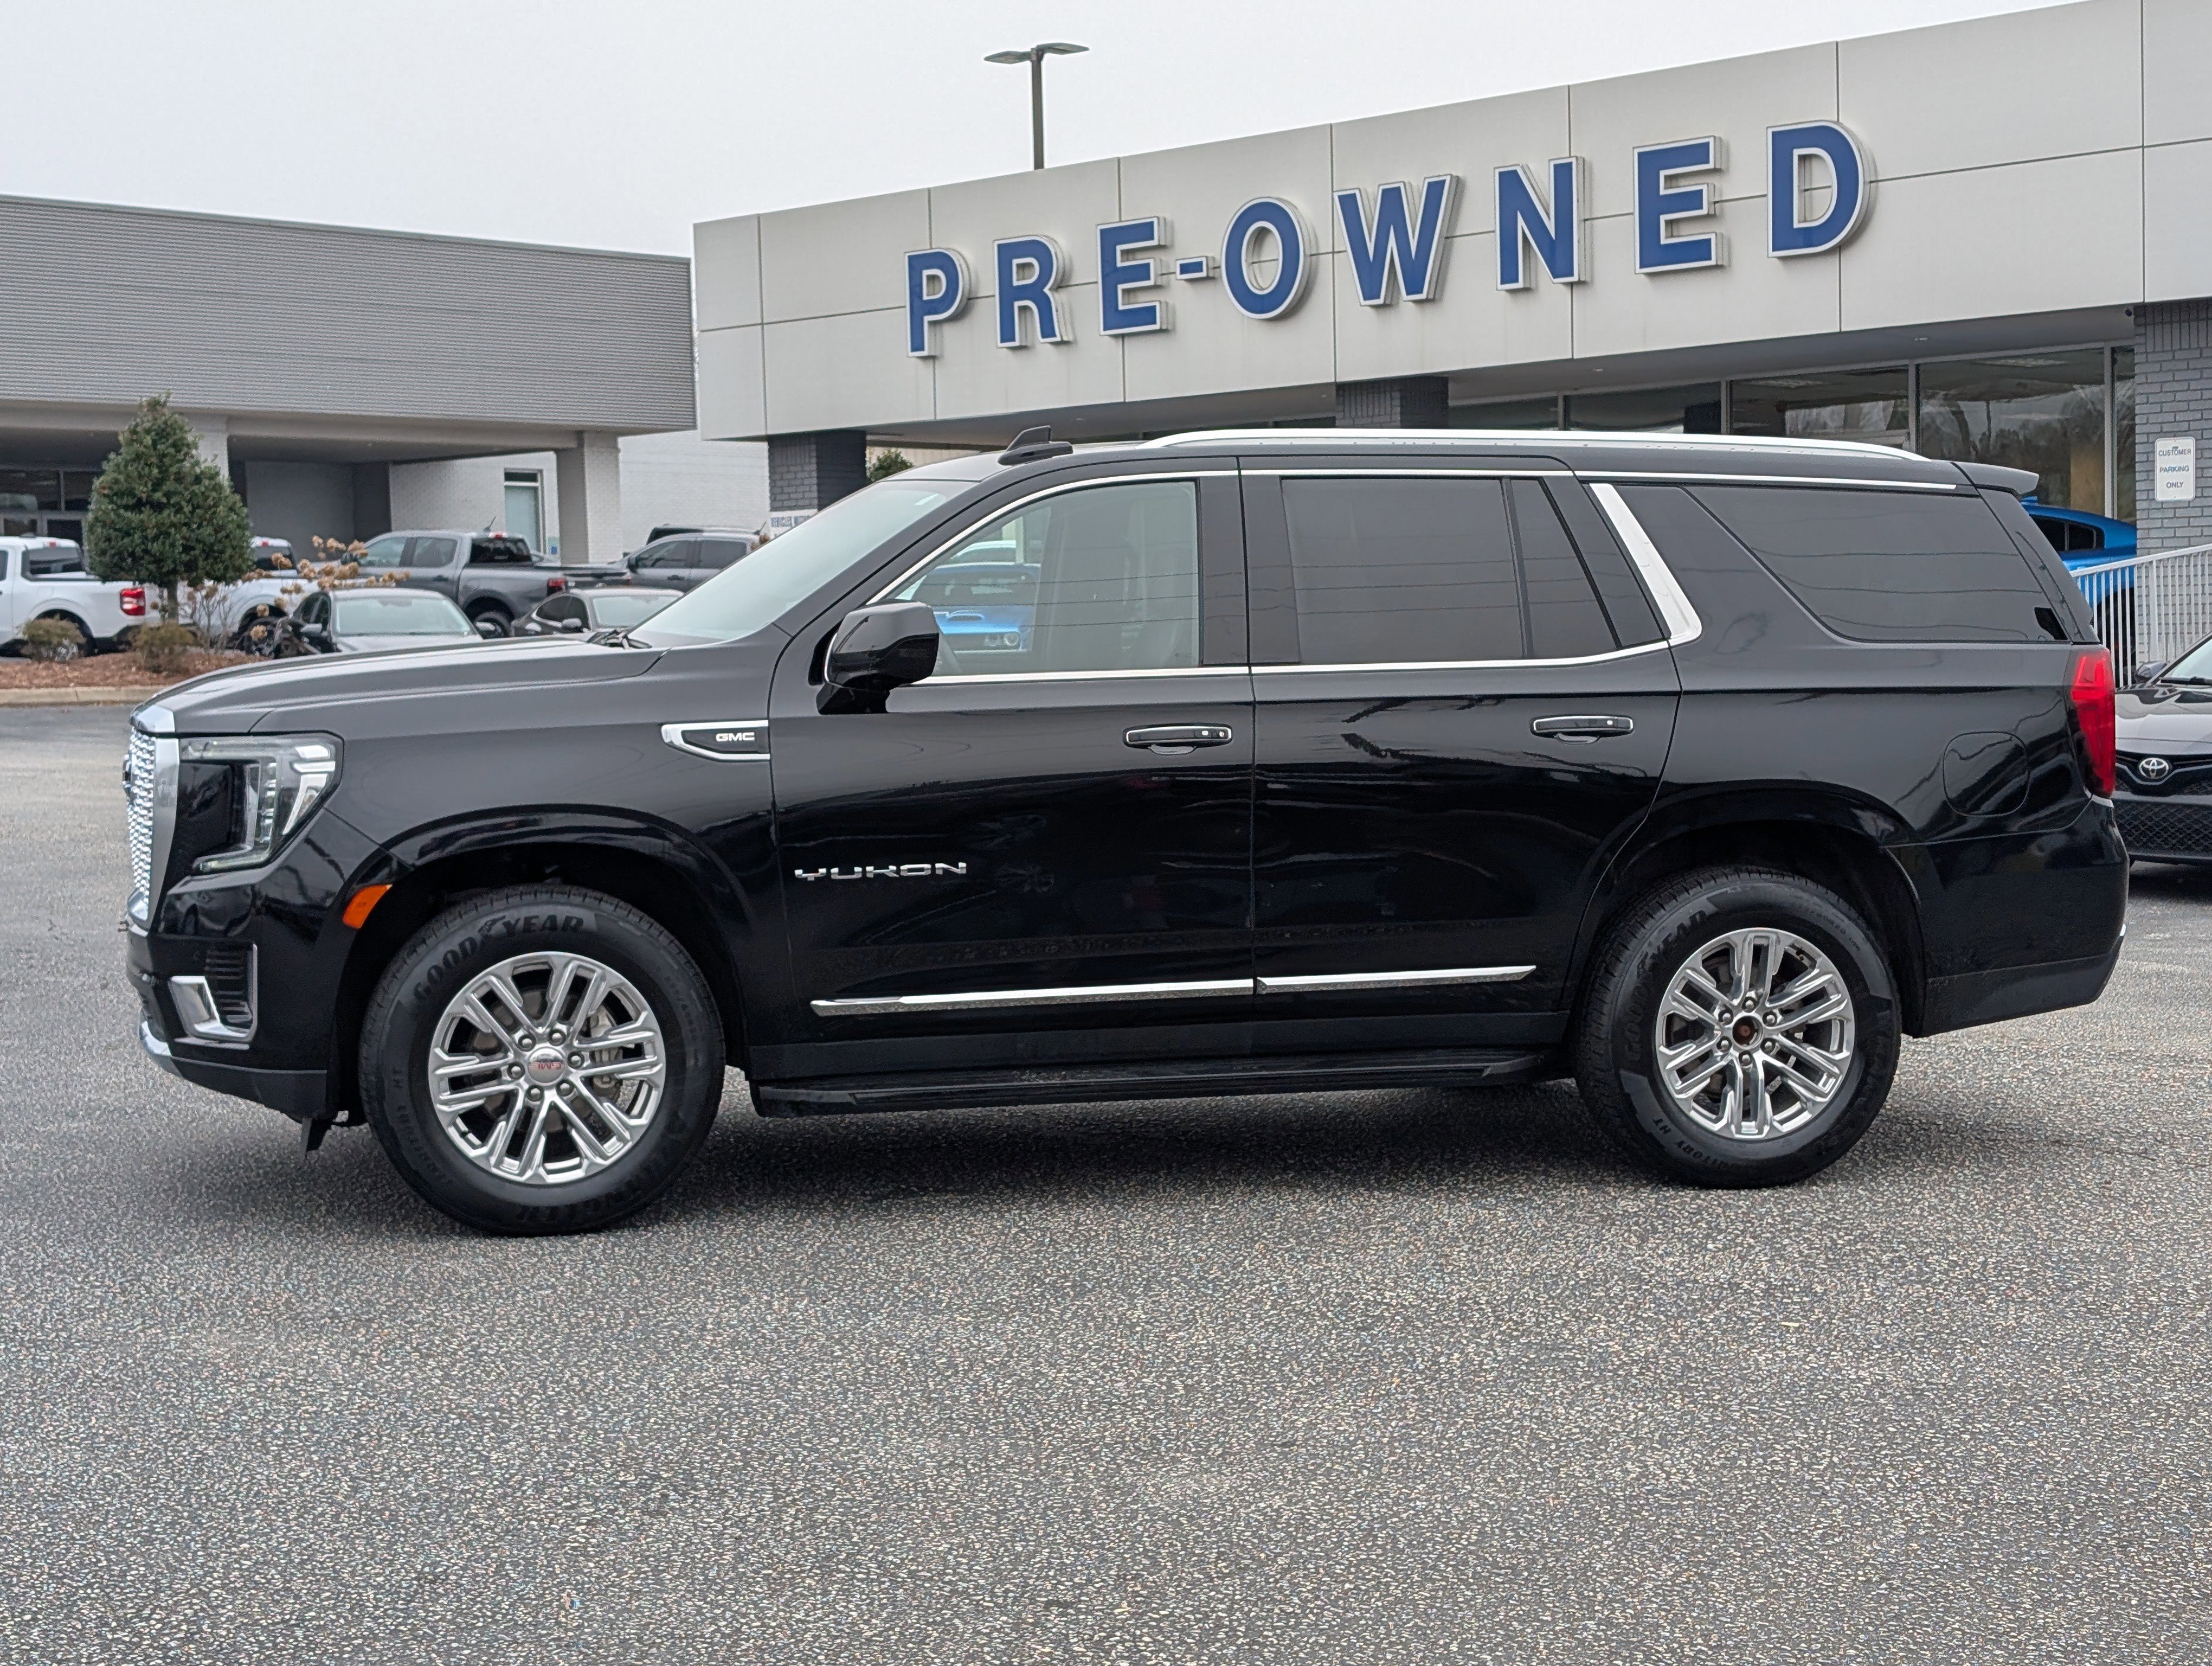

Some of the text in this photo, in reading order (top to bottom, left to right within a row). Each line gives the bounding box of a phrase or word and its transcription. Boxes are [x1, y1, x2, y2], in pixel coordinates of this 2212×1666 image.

[905, 120, 1866, 357] PRE-OWNED
[2158, 448, 2192, 457] CUSTOMER
[2159, 465, 2190, 473] PARKING
[716, 732, 755, 742] GMC
[794, 862, 967, 881] YUKON
[413, 914, 585, 1002] GOODYEAR
[529, 1061, 562, 1070] GMC
